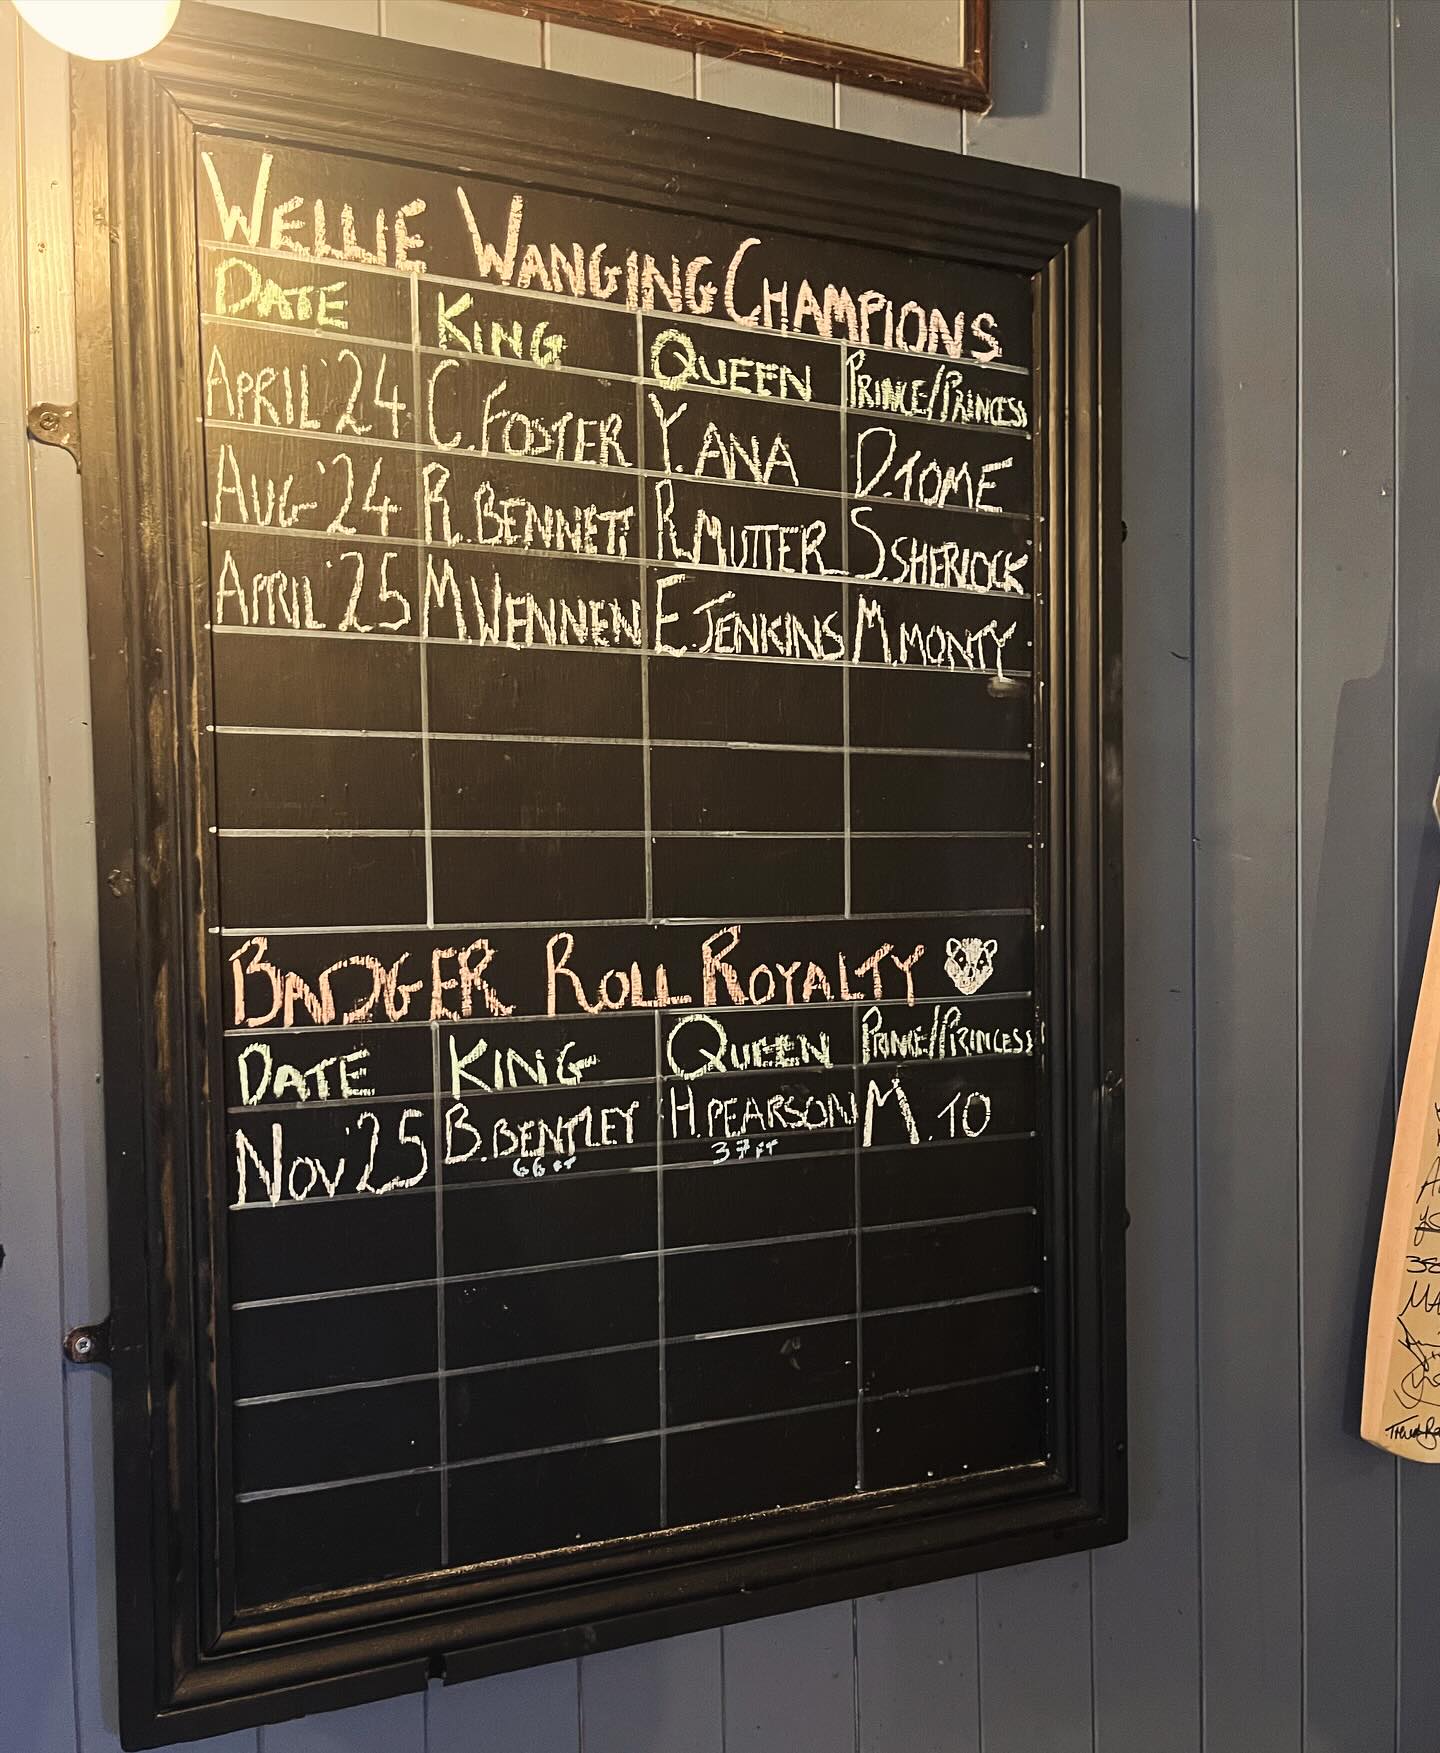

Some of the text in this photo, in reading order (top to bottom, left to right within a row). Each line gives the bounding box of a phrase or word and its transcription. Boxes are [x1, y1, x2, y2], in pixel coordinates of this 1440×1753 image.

[201, 151, 1003, 363] WELLIE WANGING CHAMPIONS
[214, 257, 348, 330] DATE
[437, 291, 567, 369] KING
[650, 328, 812, 402] QUEEN
[206, 344, 321, 430] APRIL
[216, 549, 327, 631] APRIL
[228, 924, 926, 1030] BADGER ROLL ROYALTY
[237, 1041, 376, 1106] DATE
[448, 1034, 602, 1100] KING
[666, 1012, 834, 1081] QUEEN
